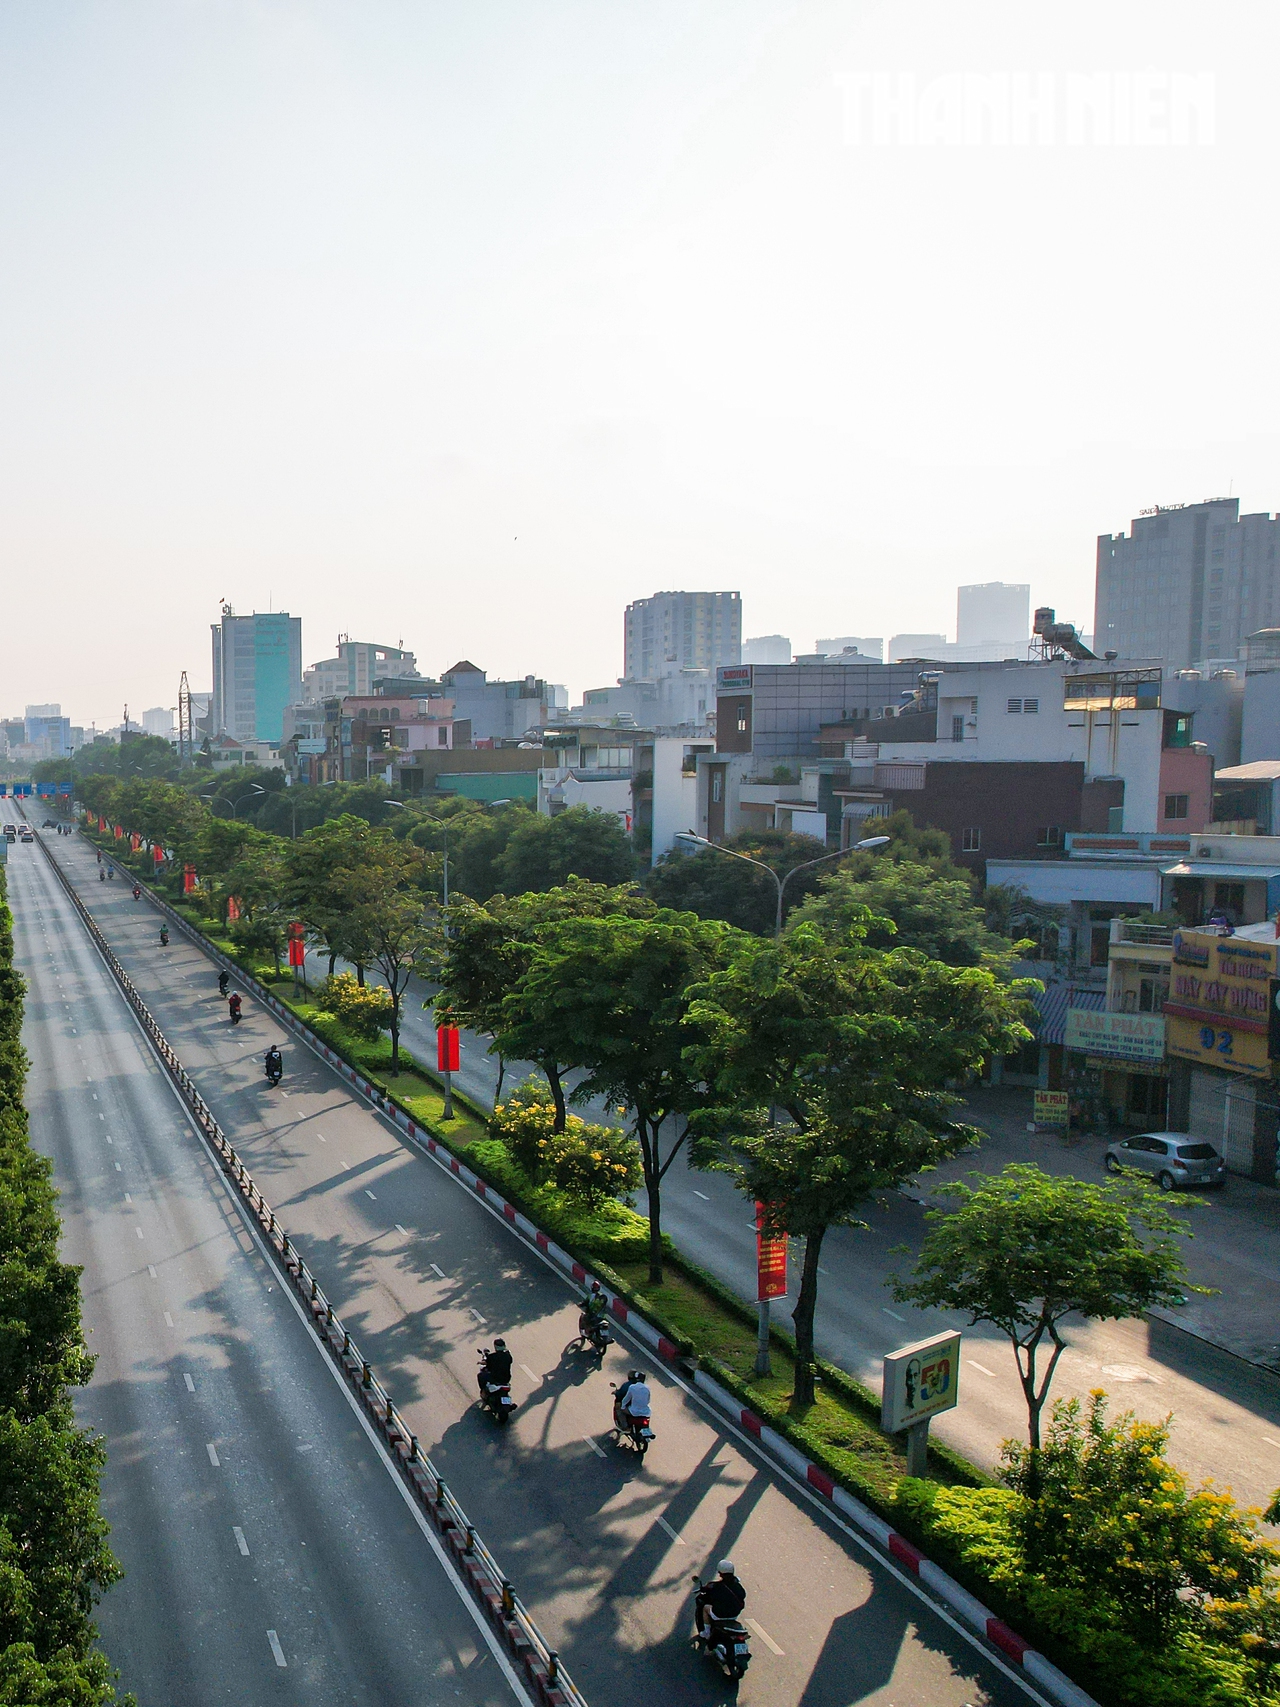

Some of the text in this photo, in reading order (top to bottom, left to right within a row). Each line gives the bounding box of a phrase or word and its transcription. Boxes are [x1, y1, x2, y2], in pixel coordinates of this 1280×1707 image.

[1073, 1011, 1156, 1035] TÂN PHÁT
[1200, 1027, 1233, 1054] 92
